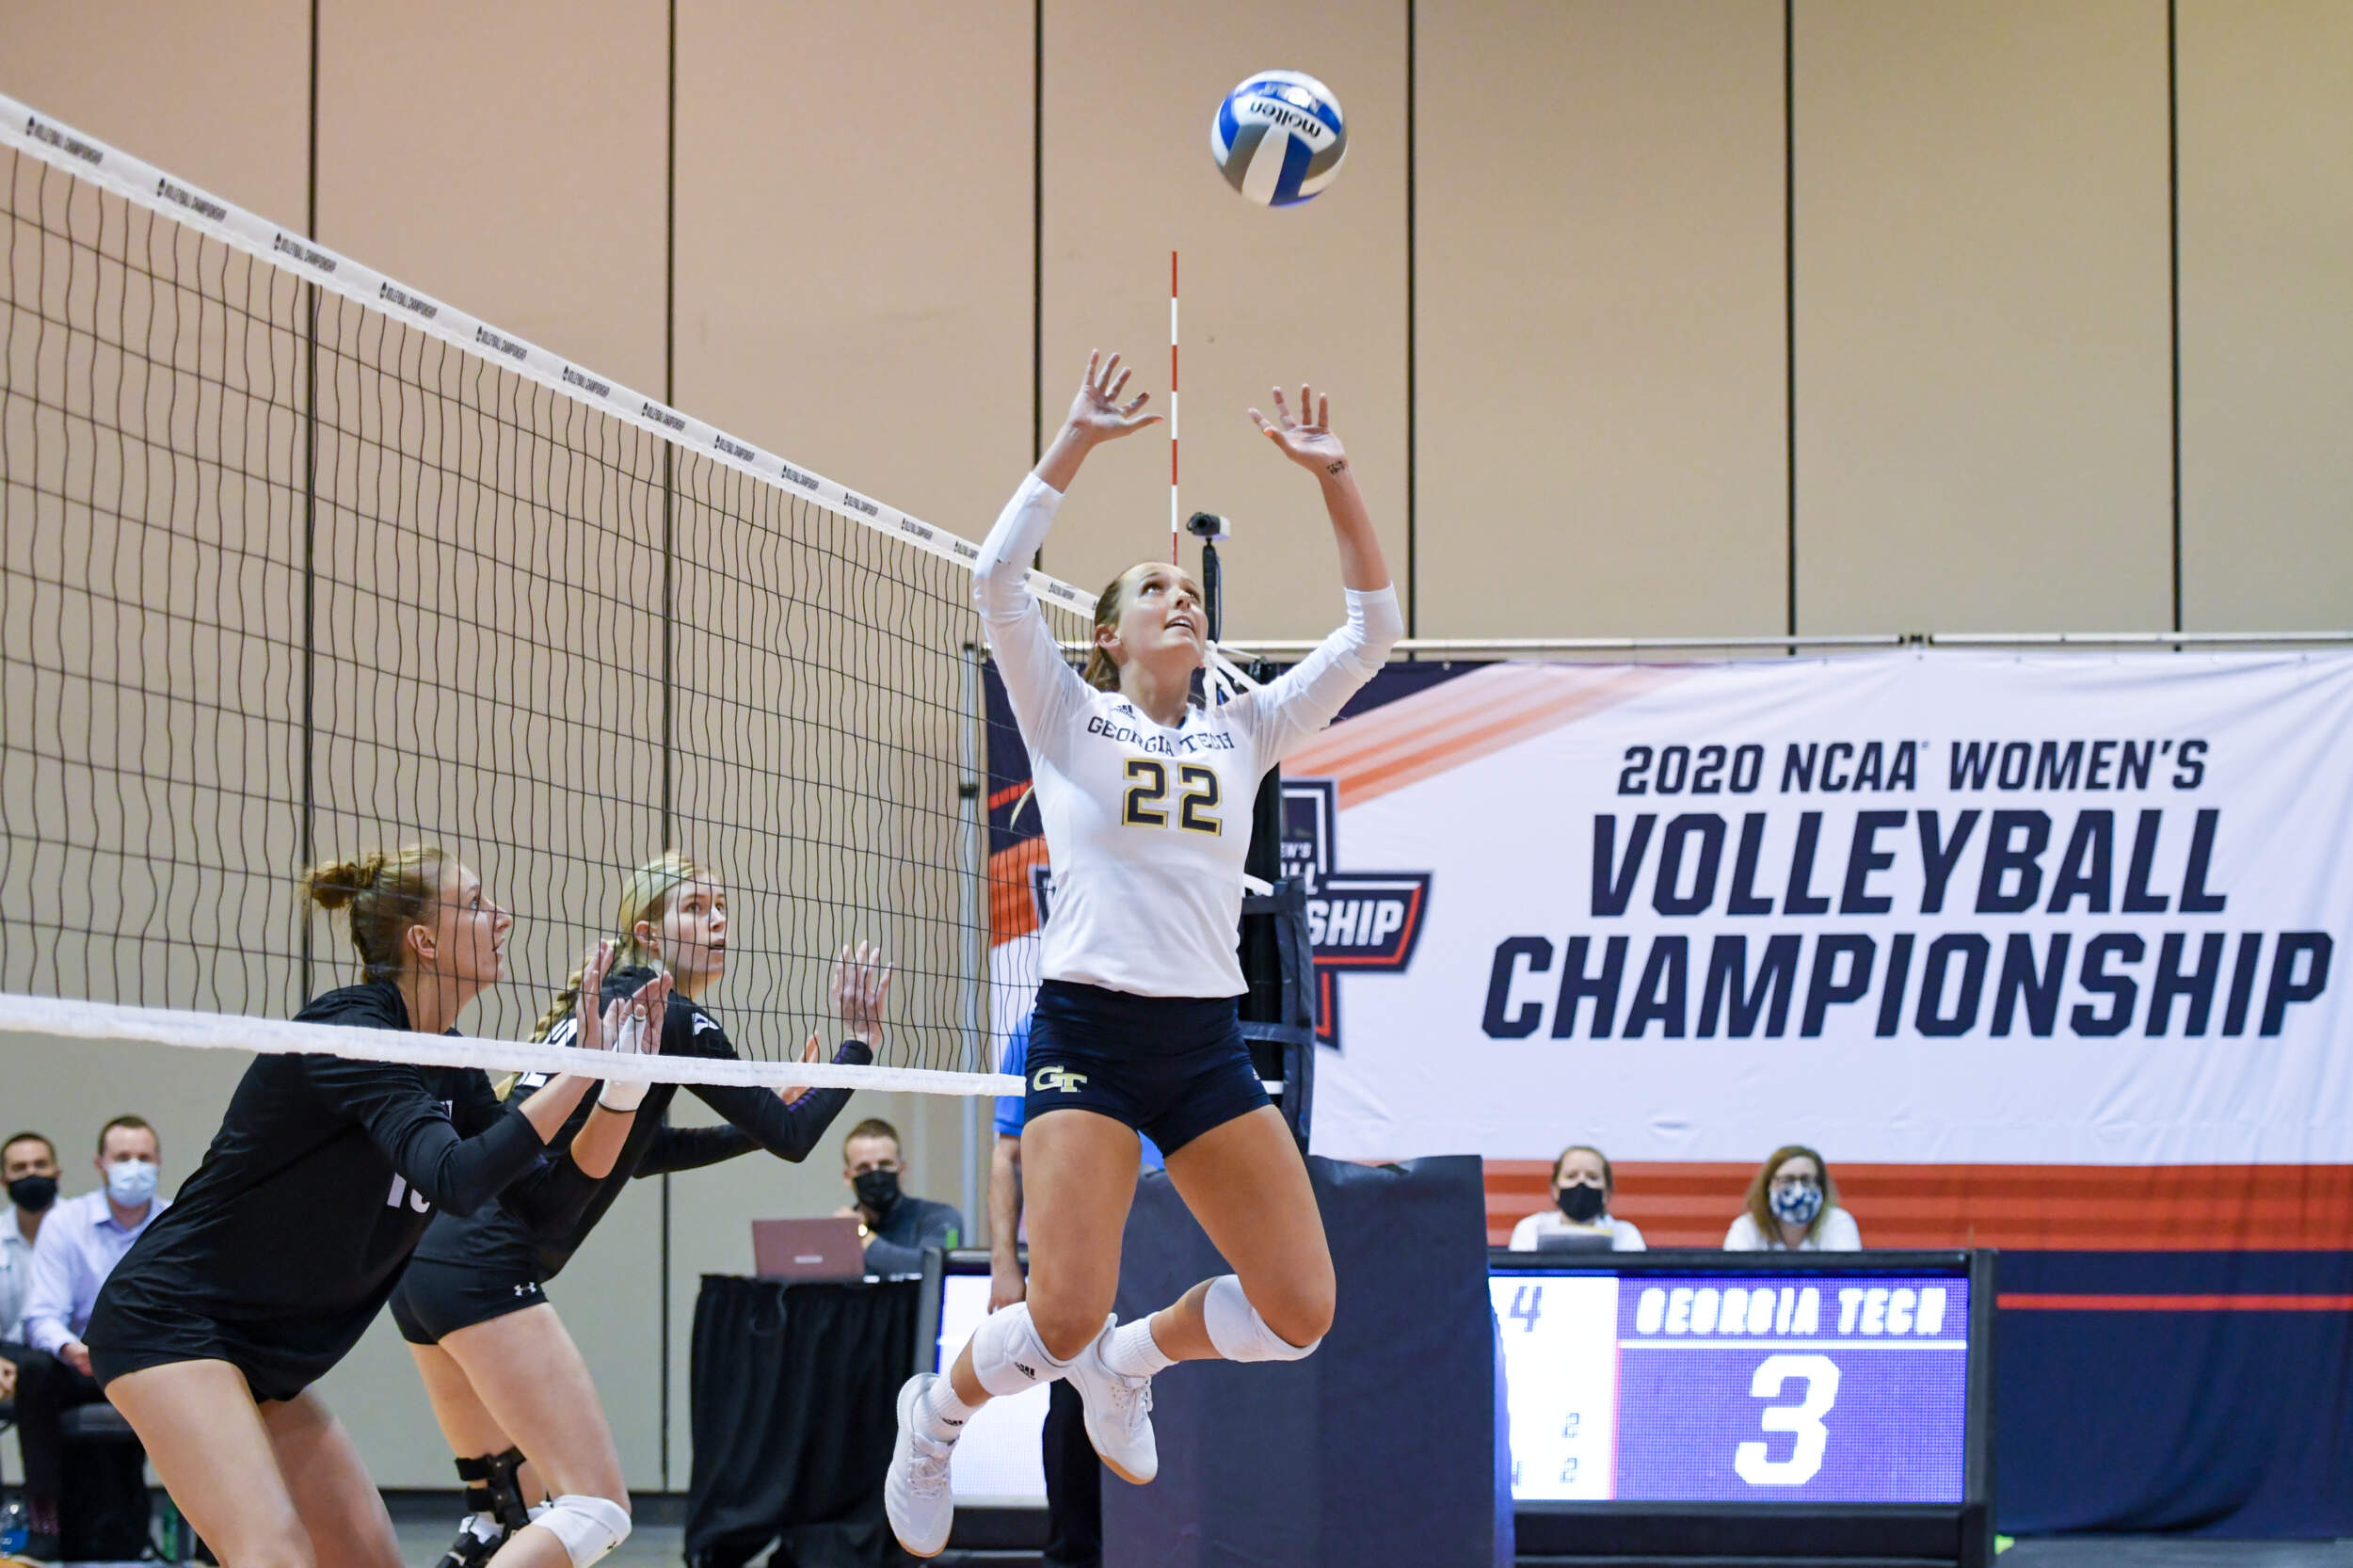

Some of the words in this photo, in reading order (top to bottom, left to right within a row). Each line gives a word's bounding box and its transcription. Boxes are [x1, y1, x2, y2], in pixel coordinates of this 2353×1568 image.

[1249, 100, 1322, 139] molten
[1087, 716, 1176, 757] GEORGIA
[1178, 731, 1235, 754] TECH
[1617, 744, 1765, 795] 2020
[1780, 740, 1917, 793] NCAA
[1949, 739, 2209, 792] WOMEN'S
[1121, 757, 1223, 837] 22
[1591, 808, 2227, 918] VOLLEYBALL
[1481, 931, 2334, 1040] CHAMPIONSHIP
[1033, 1065, 1088, 1093] GT
[1510, 1286, 1543, 1333] 4
[1636, 1288, 1820, 1335] GEORGIA
[1836, 1288, 1947, 1335] TECH
[1734, 1354, 1841, 1485] 3
[1561, 1457, 1577, 1483] 2
